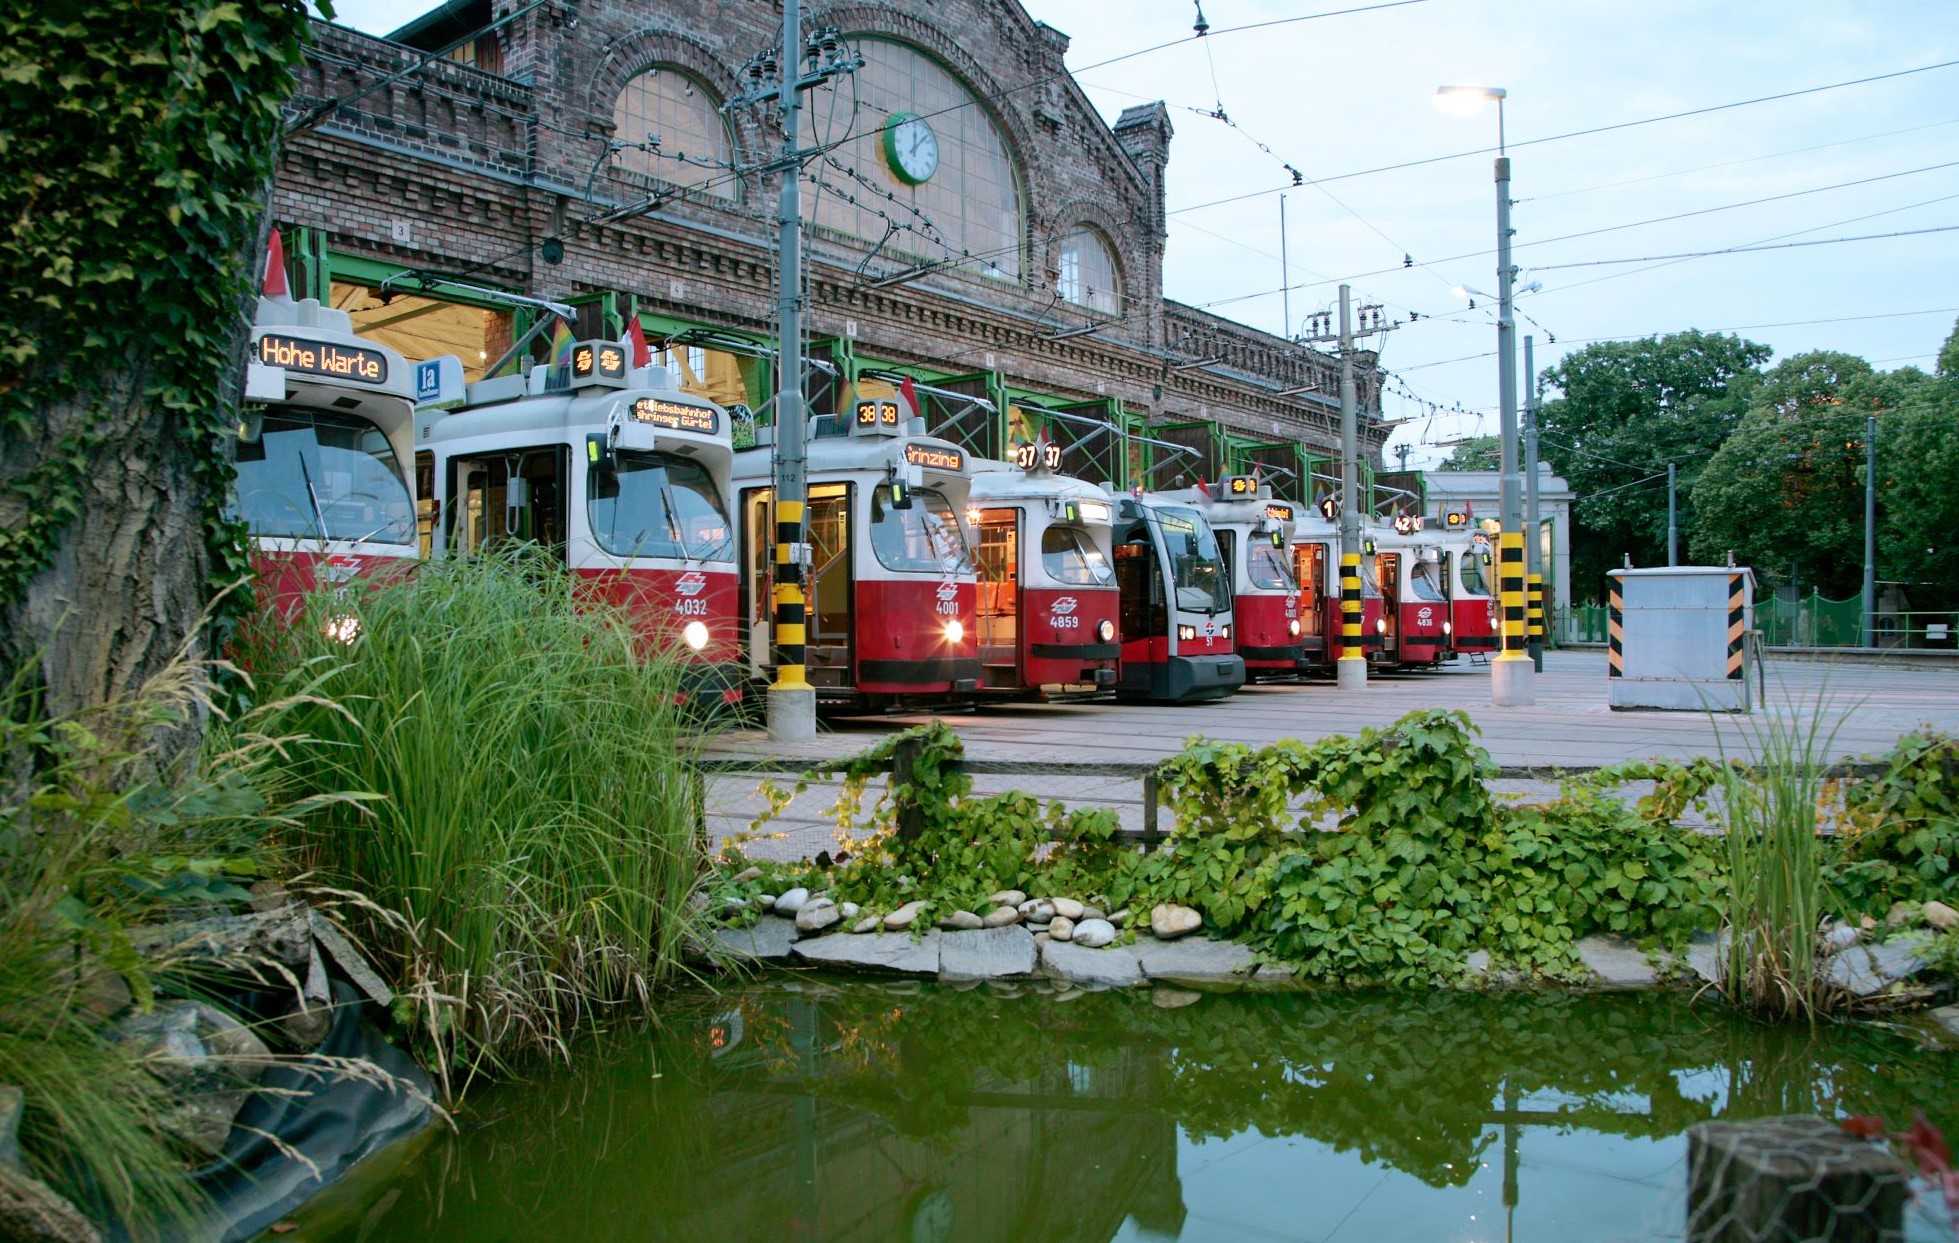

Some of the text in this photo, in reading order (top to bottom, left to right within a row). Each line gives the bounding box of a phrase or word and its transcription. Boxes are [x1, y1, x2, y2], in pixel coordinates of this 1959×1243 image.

[263, 337, 379, 378] Hohe Warte
[421, 366, 436, 390] 1a
[859, 405, 877, 423] 38
[881, 405, 897, 423] 38
[1018, 445, 1036, 468] 37
[1045, 446, 1060, 468] 37
[1323, 500, 1333, 518] 1
[1395, 516, 1411, 531] 42
[675, 599, 707, 615] 4032
[936, 601, 959, 615] 4001
[1050, 616, 1079, 628] 4859
[1206, 636, 1213, 646] 51
